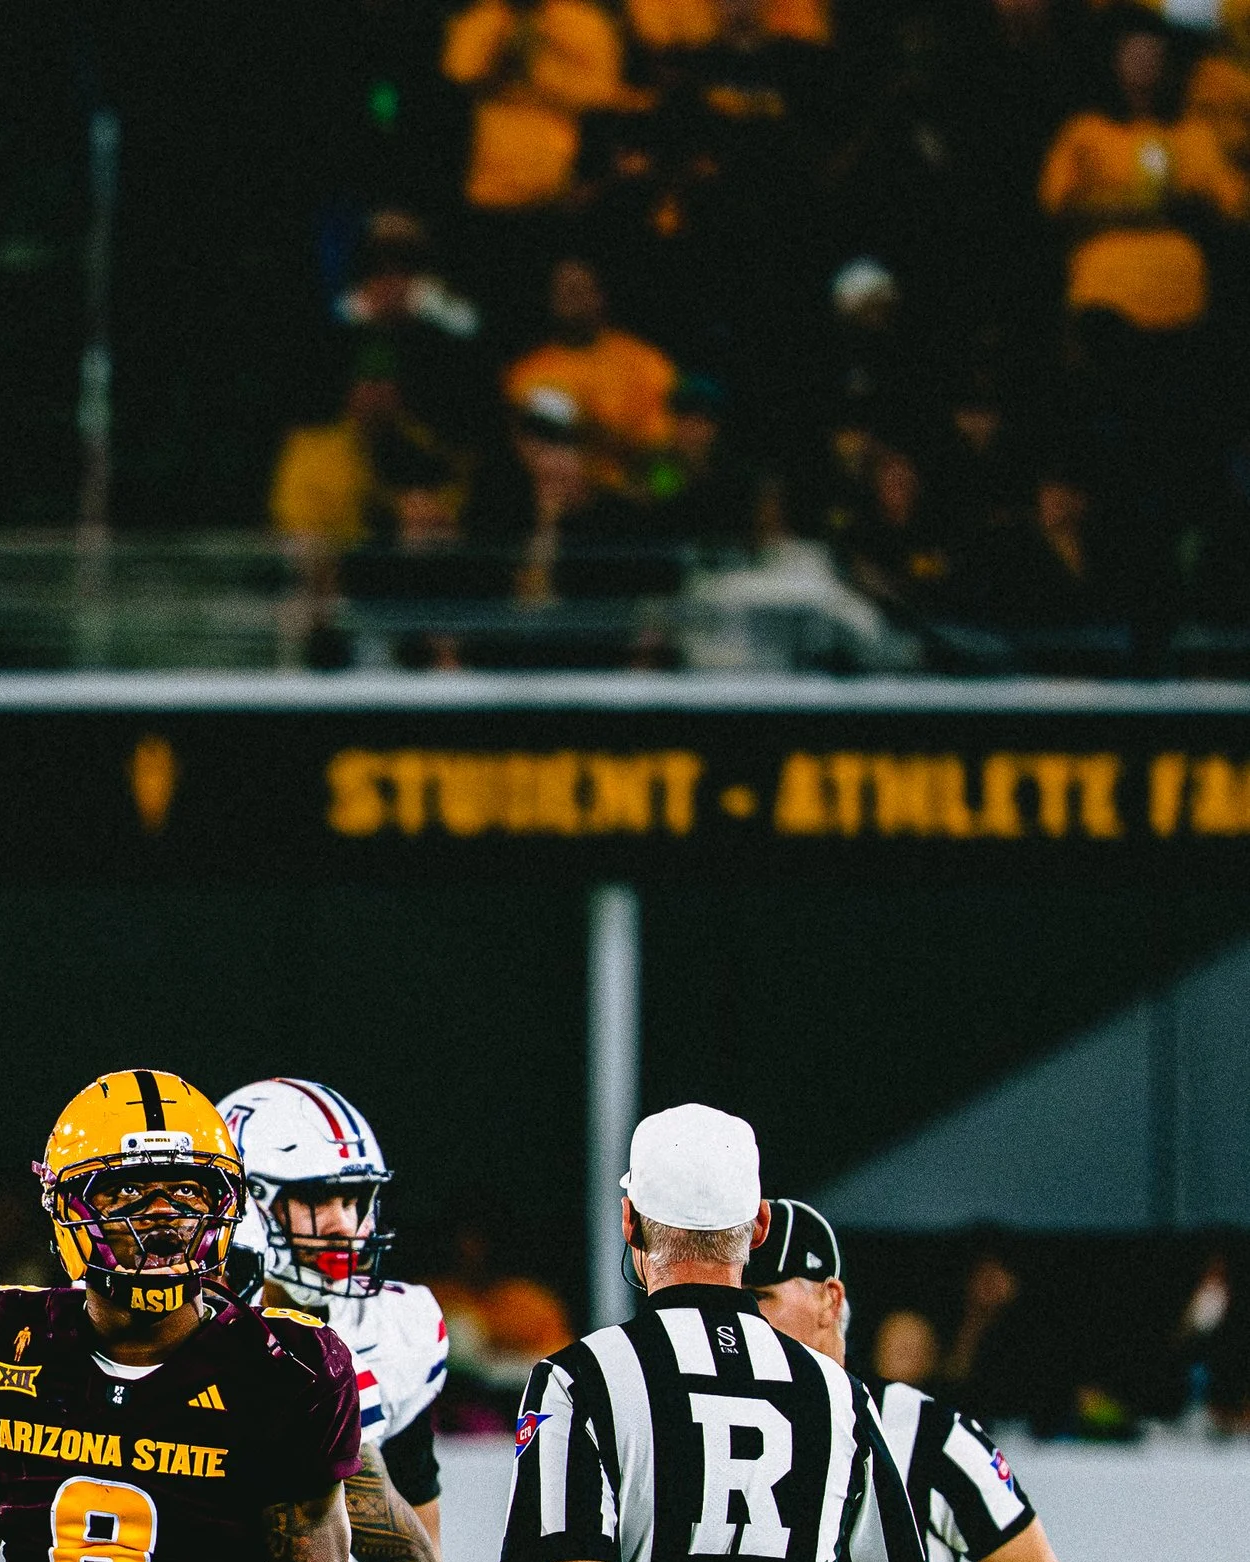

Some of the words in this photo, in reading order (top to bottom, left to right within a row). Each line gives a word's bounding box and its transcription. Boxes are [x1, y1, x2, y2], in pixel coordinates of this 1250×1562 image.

[326, 749, 702, 836] STUDENT
[773, 752, 1120, 837] ATHLETE
[131, 1284, 184, 1312] ASU
[0, 1419, 122, 1467] ARIZONA
[131, 1439, 229, 1477] STATE
[688, 1393, 792, 1558] R
